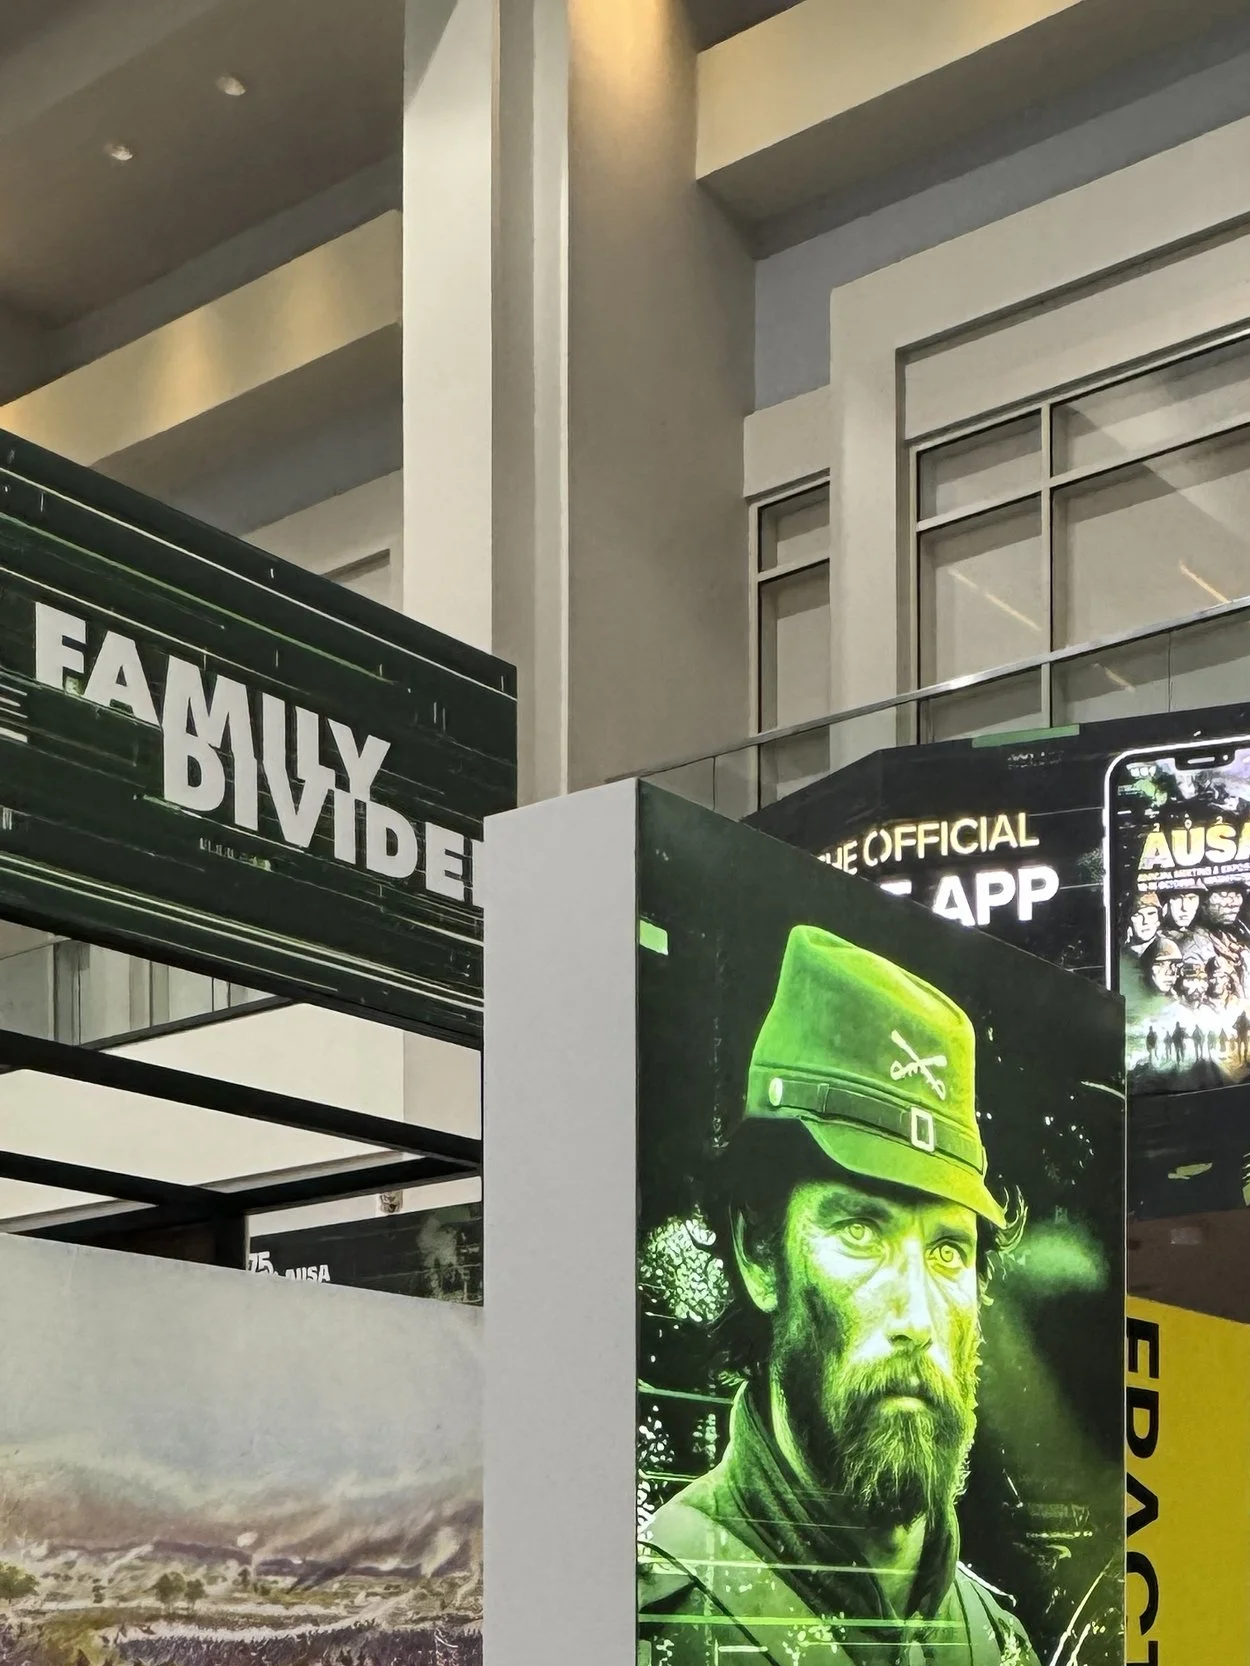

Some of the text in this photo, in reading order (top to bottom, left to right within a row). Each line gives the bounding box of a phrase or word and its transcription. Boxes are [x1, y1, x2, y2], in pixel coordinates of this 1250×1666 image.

[35, 602, 390, 798] FAMILY
[817, 812, 1040, 875] HE OFFICIAL
[931, 865, 1060, 927] APP
